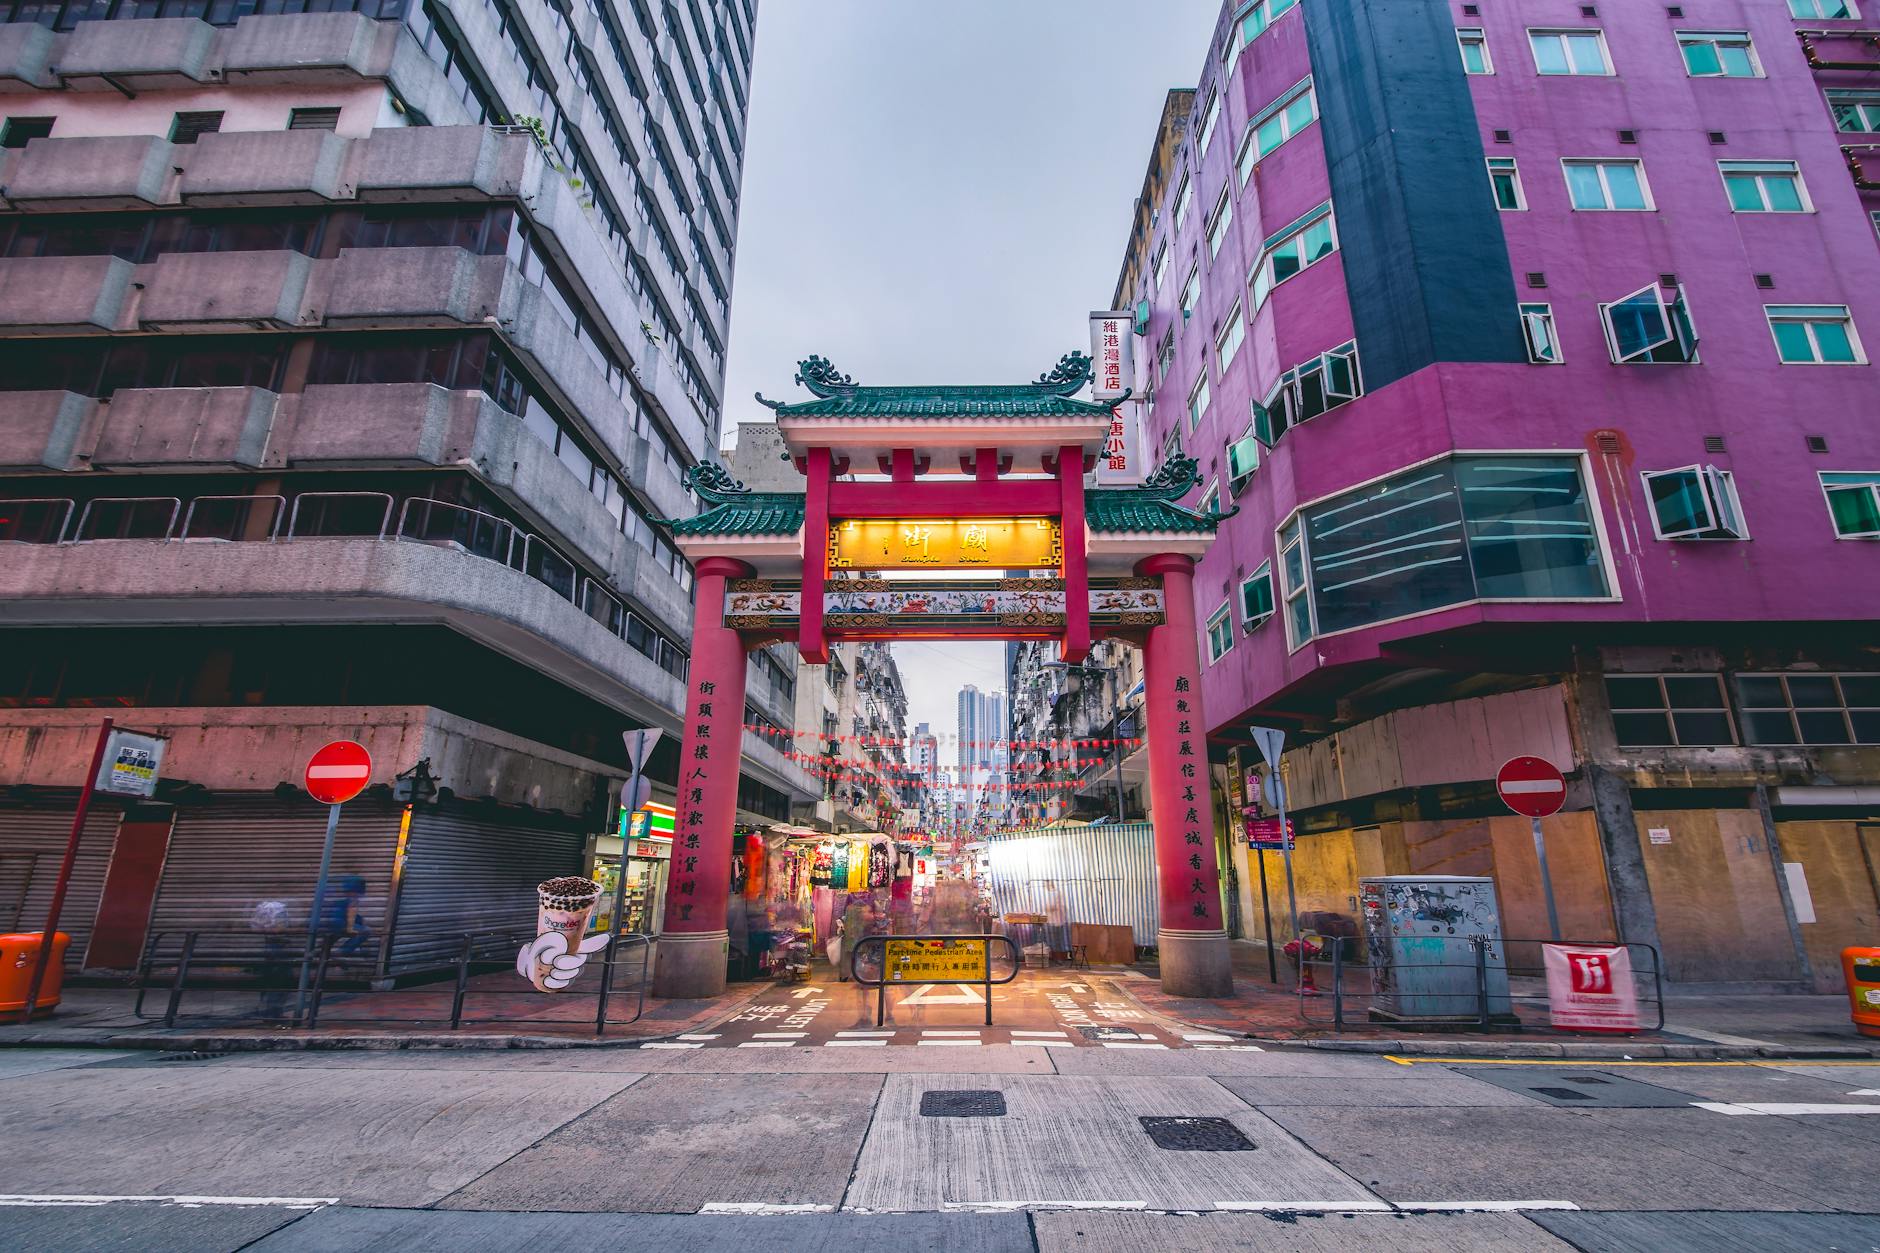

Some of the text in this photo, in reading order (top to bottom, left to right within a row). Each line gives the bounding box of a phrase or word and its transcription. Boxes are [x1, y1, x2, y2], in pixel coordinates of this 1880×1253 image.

[1103, 320, 1121, 390] 維港灣酒店
[888, 948, 921, 956] Part-time
[925, 948, 964, 956] Pedestrian
[776, 998, 833, 1029] LOOK LEFT
